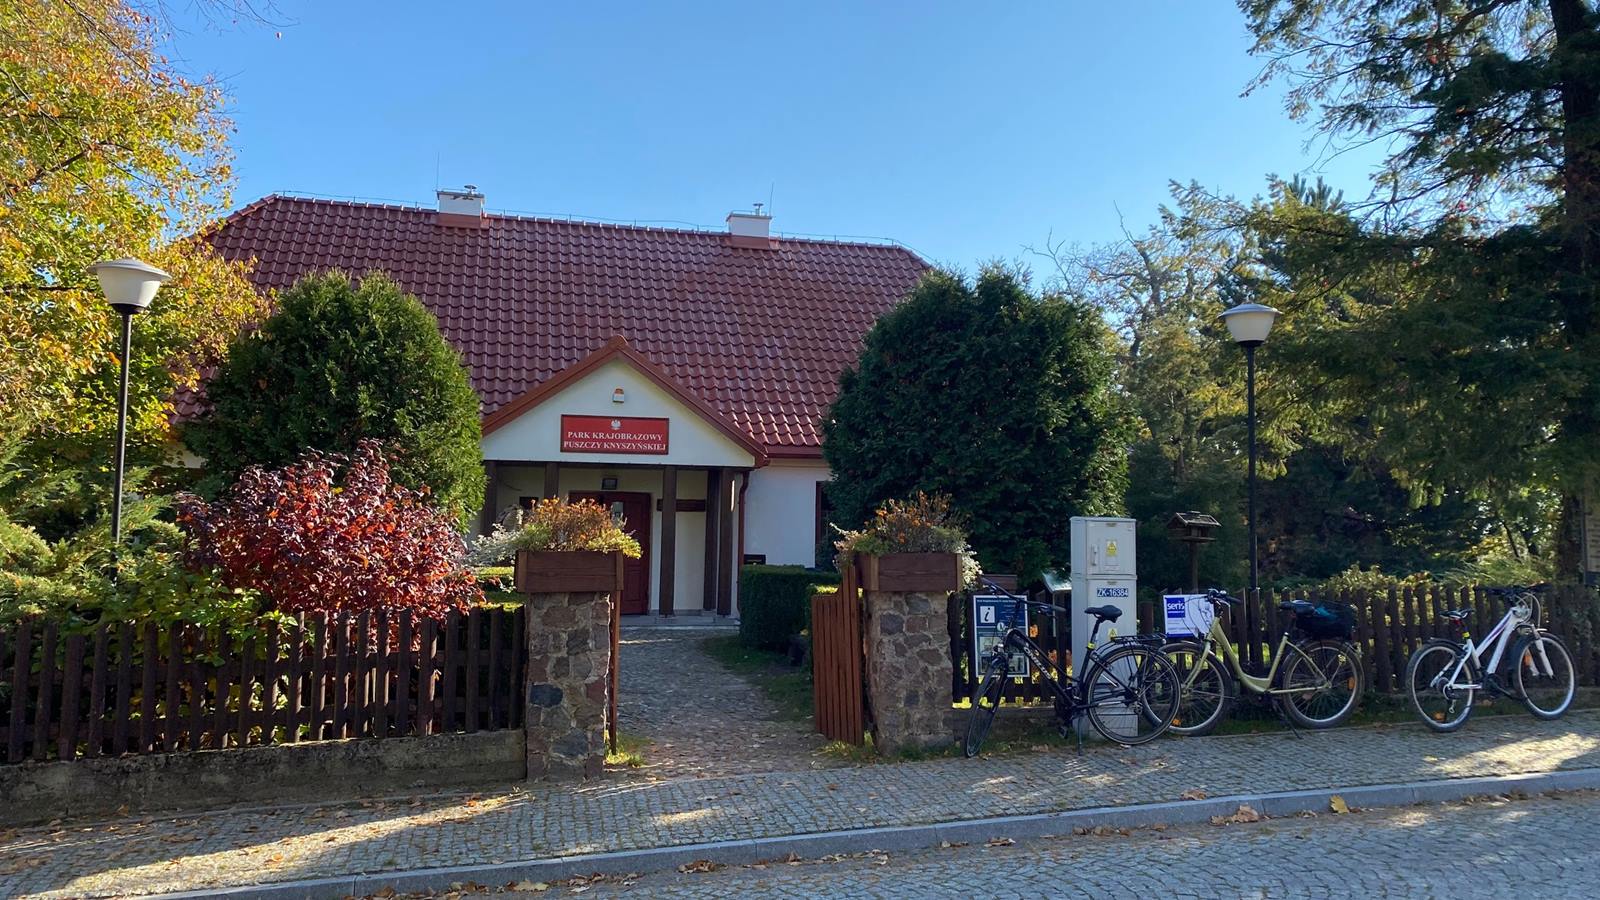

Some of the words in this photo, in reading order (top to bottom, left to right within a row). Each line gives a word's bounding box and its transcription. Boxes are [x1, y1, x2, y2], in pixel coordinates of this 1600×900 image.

[568, 431, 591, 439] PARK
[592, 432, 663, 441] KRAJOBRAZOWY
[563, 441, 603, 449] PUSZCZY
[603, 441, 666, 451] KNYSZYŃSKIEJ
[1097, 588, 1129, 597] ZK-16384
[1167, 600, 1185, 610] seris
